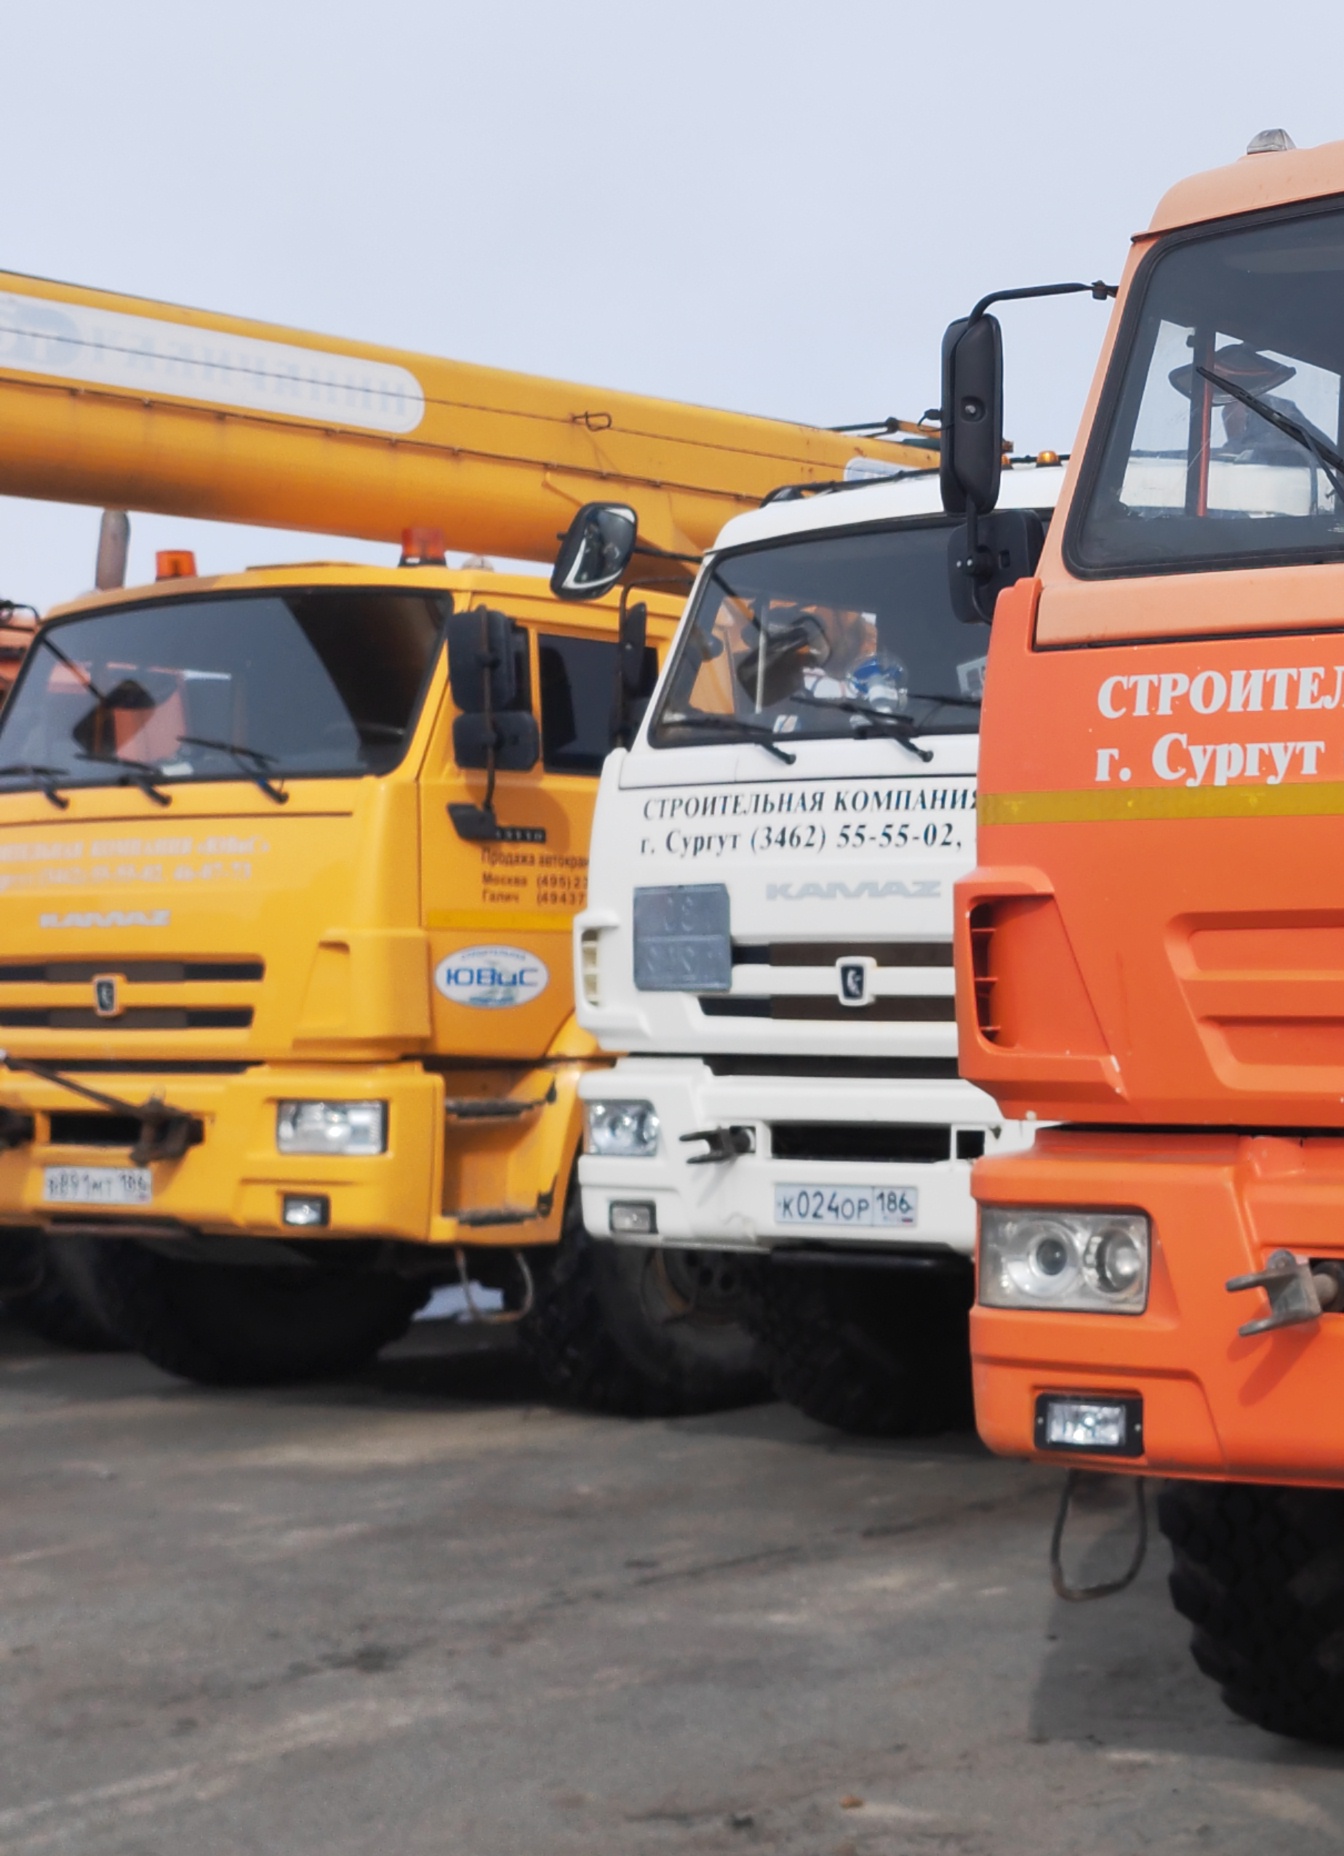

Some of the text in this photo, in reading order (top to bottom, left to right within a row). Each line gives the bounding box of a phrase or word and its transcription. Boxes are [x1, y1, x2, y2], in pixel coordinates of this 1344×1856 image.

[1095, 748, 1132, 782] г.
[1152, 733, 1326, 787] Сургут
[643, 790, 826, 819] СТРОИТЕЛЬНАЯ
[665, 829, 741, 857] Сургут
[750, 825, 827, 855] (3462)
[837, 823, 962, 850] 55-55-02,
[768, 880, 941, 899] KAMAZ
[783, 1190, 911, 1220] К024ОР 186
